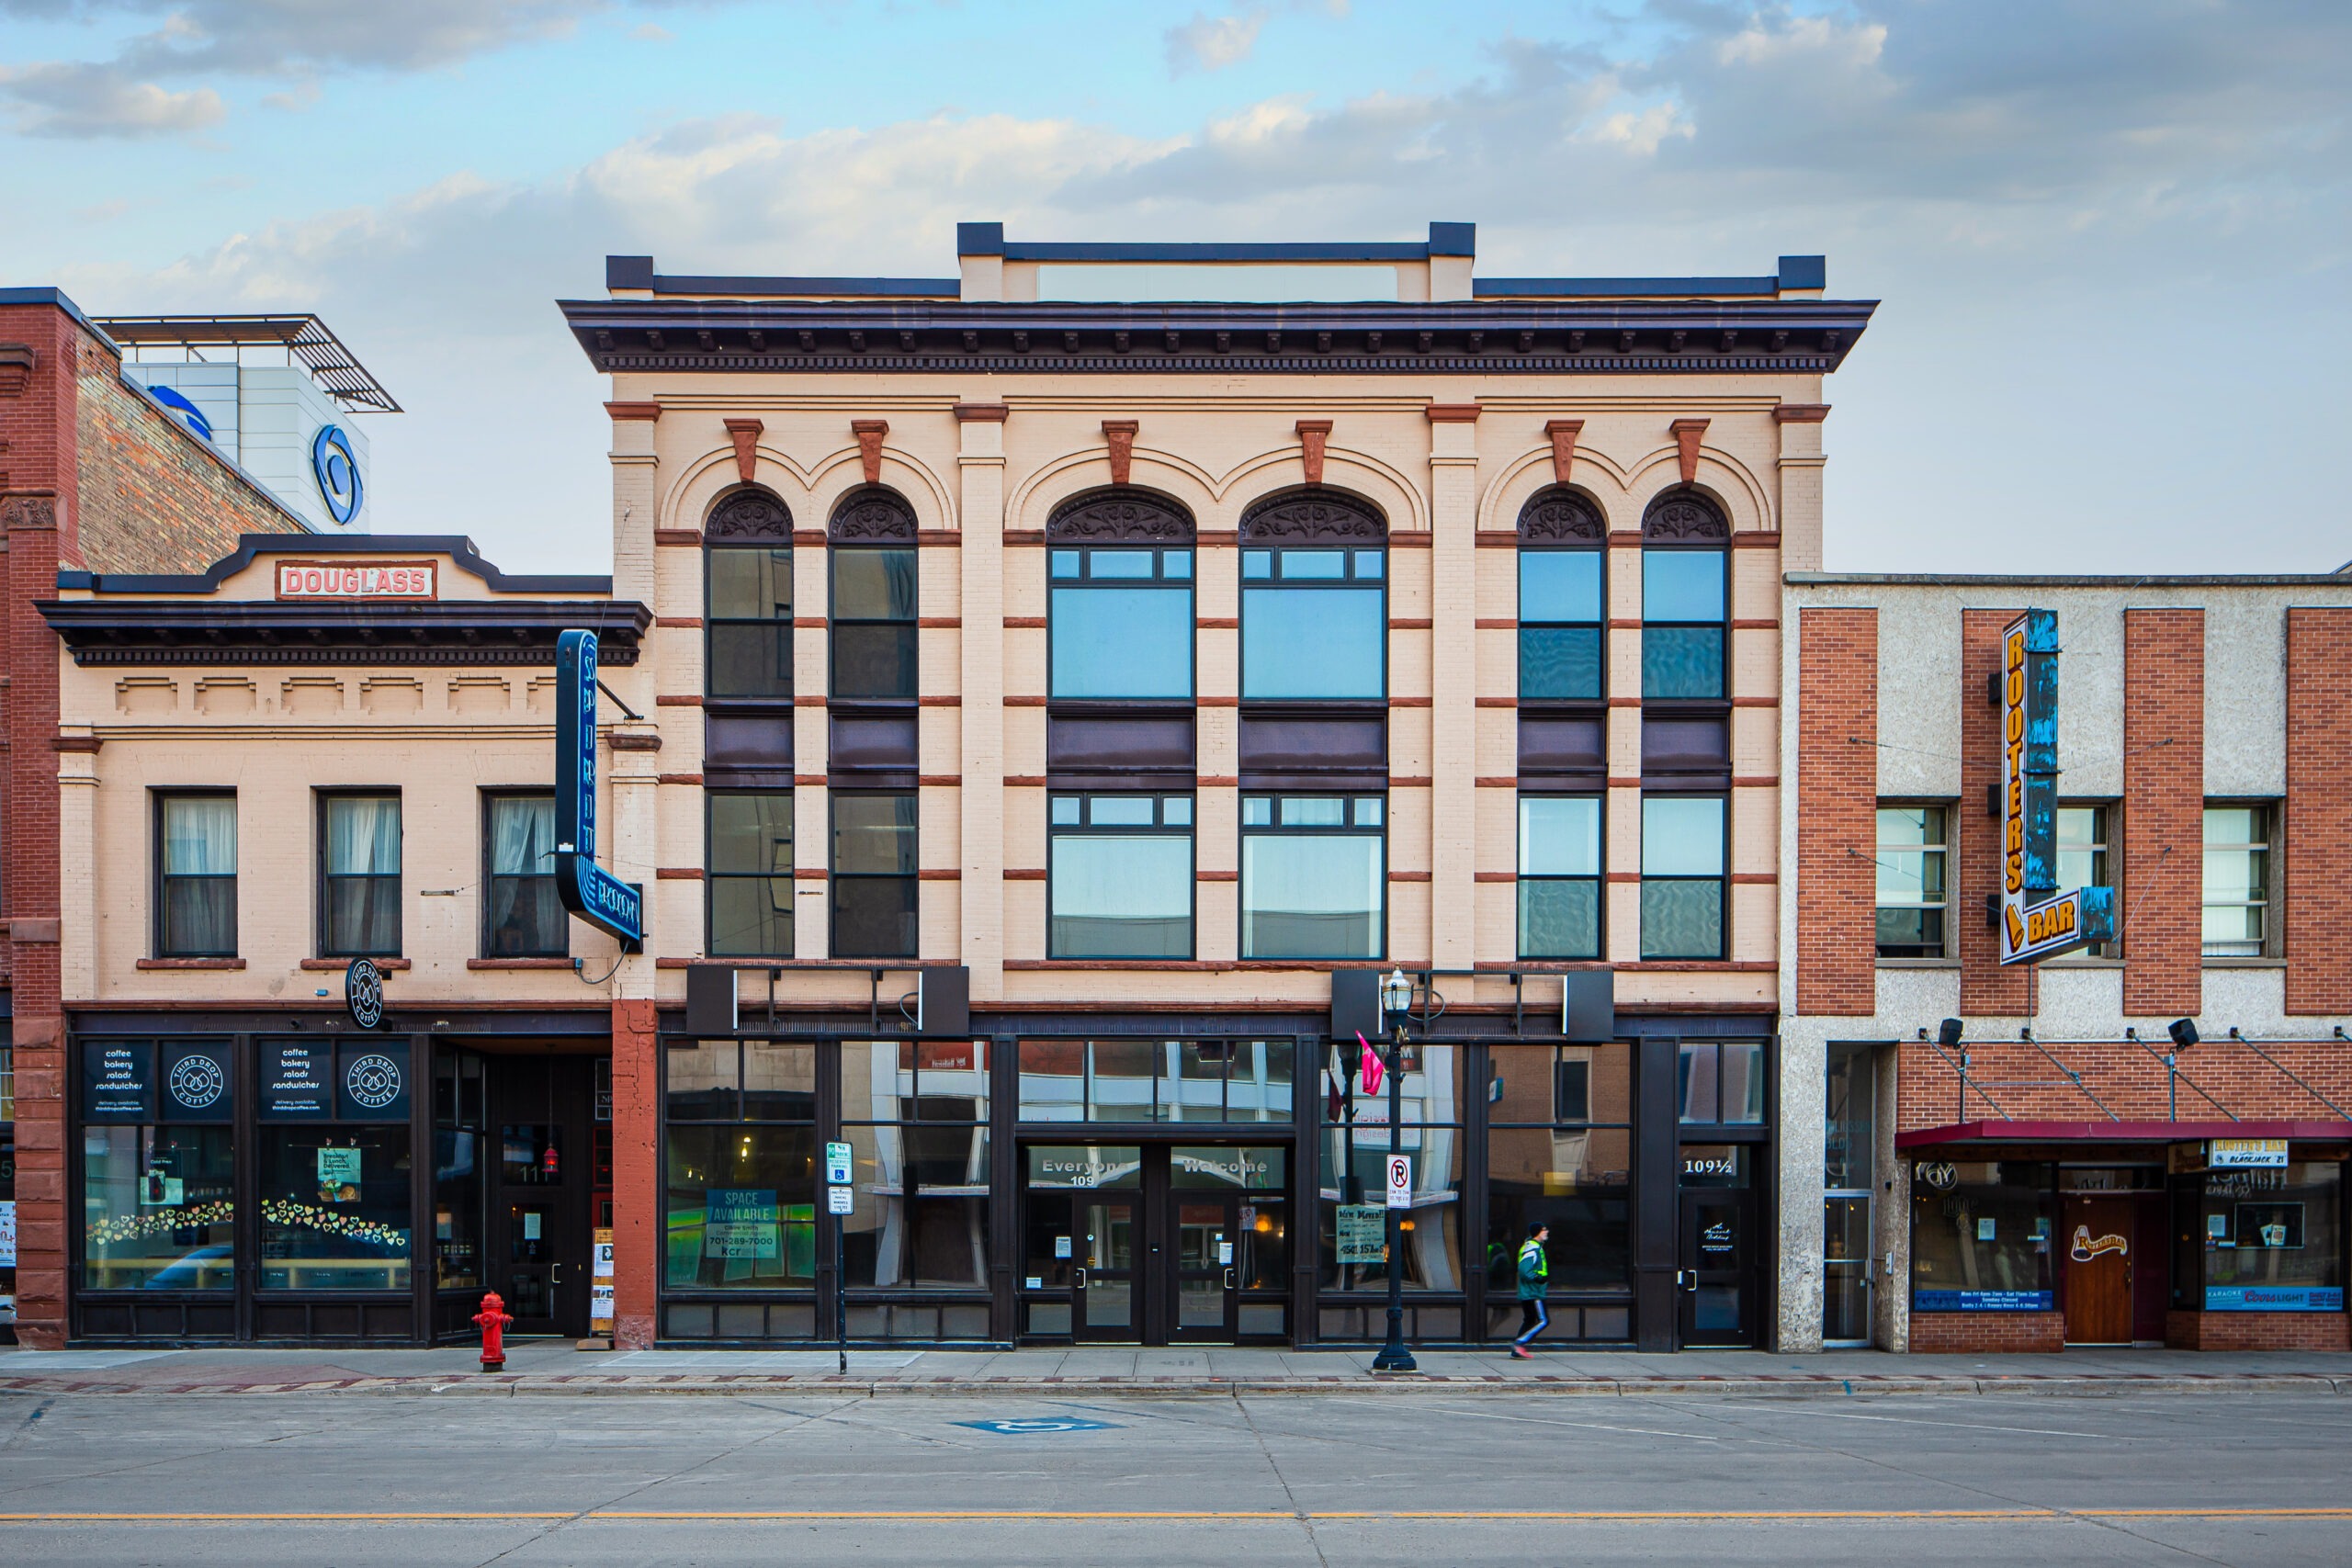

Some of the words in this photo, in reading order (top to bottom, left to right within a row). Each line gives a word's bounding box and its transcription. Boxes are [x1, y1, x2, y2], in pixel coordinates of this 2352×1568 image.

[286, 570, 425, 592] DOUGLASS
[2006, 630, 2024, 895] ROOTERS
[2028, 900, 2075, 946] BAR
[353, 964, 367, 986] THIRD
[356, 1005, 378, 1023] COFFEE
[106, 1049, 131, 1057] coffee
[282, 1048, 309, 1056] coffee
[104, 1060, 133, 1070] bakery
[174, 1059, 197, 1078] THIRD
[199, 1059, 220, 1078] DROP
[281, 1059, 310, 1069] bakery
[352, 1058, 374, 1077] THIRD
[377, 1058, 397, 1077] DROP
[106, 1071, 131, 1079] salads
[283, 1070, 309, 1078] salads
[96, 1082, 142, 1090] sandwiches
[272, 1081, 320, 1089] sandwiches
[178, 1092, 215, 1105] COFFEE
[356, 1091, 392, 1104] COFFEE
[1183, 1160, 1267, 1172] Welcome
[2229, 1156, 2272, 1164] BLACKJACK
[1043, 1159, 1128, 1175] Everyone
[1070, 1176, 1094, 1186] 109
[725, 1192, 758, 1205] SPACE
[714, 1208, 769, 1221] AVAILABLE
[721, 1247, 741, 1257] kcr
[2277, 1293, 2304, 1302] LIGHT
